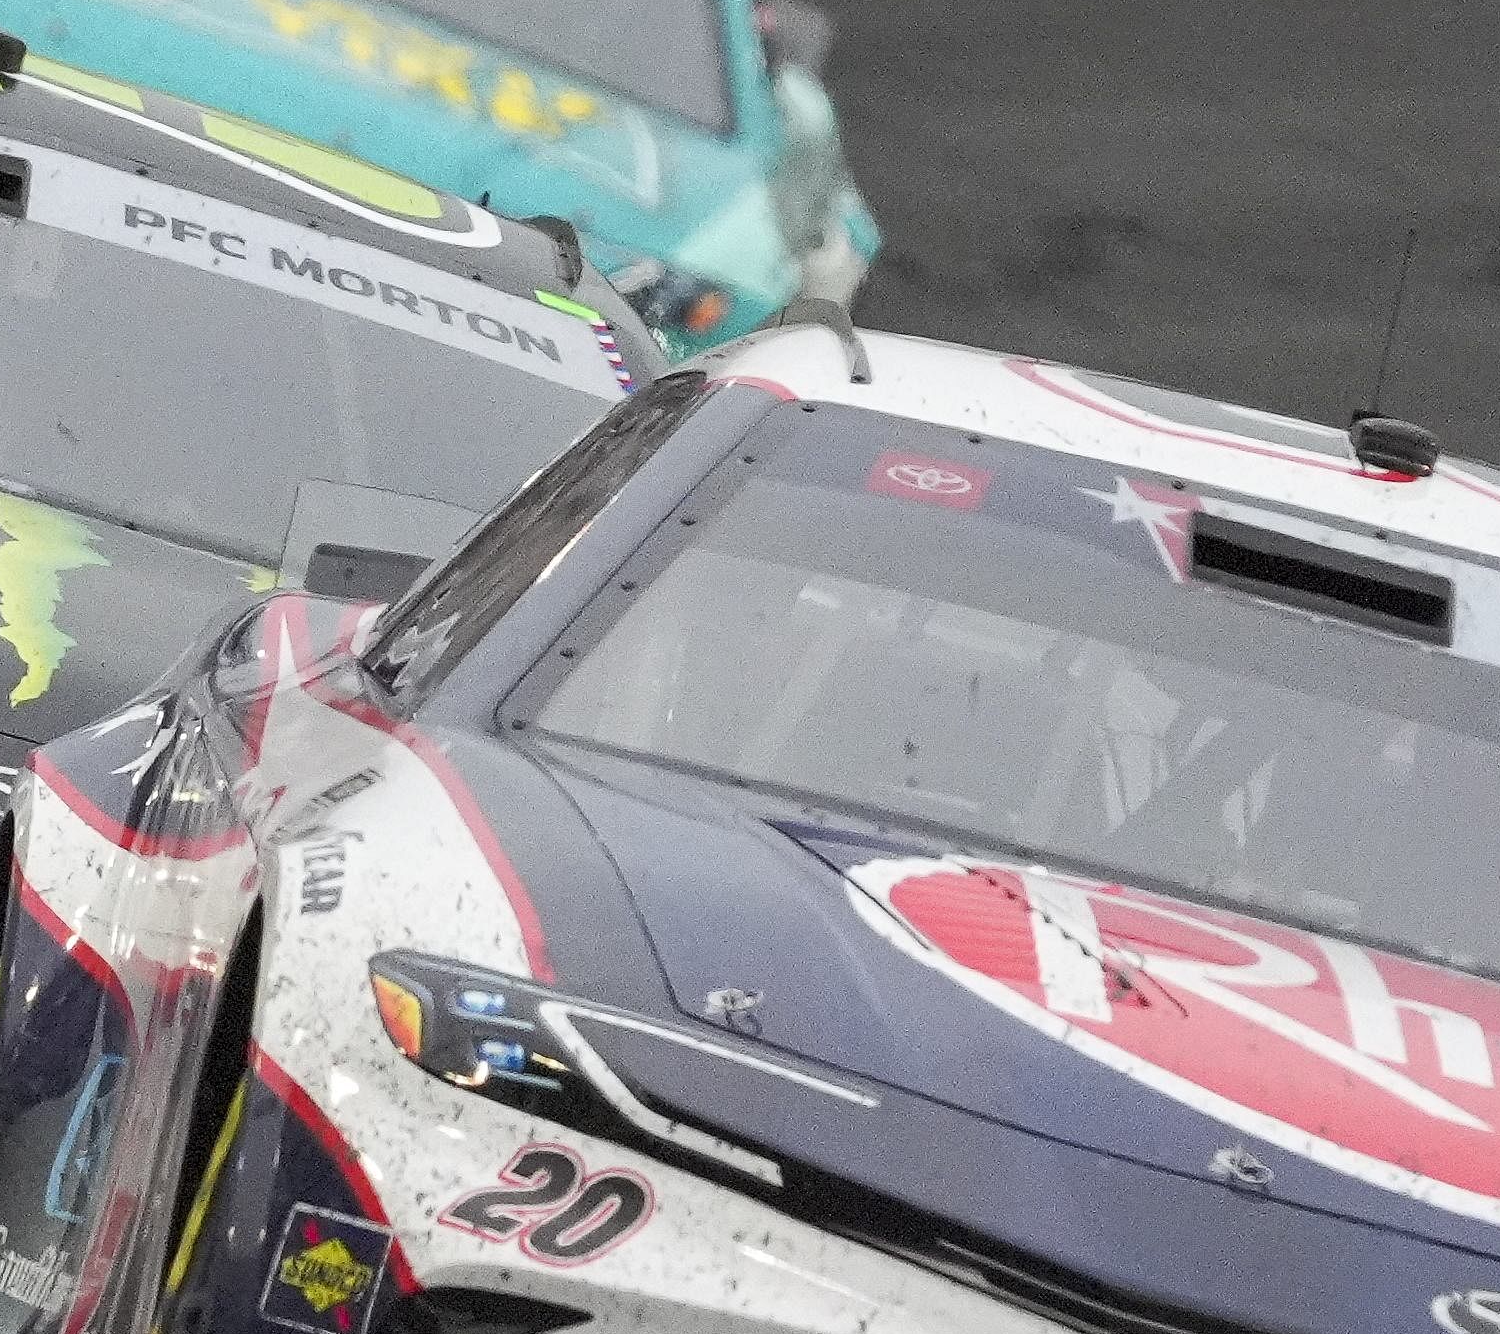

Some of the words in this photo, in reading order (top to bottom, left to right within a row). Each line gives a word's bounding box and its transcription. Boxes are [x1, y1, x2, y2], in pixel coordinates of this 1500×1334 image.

[122, 202, 248, 261] PFC
[268, 246, 563, 364] MORTON
[438, 1143, 656, 1268] 20
